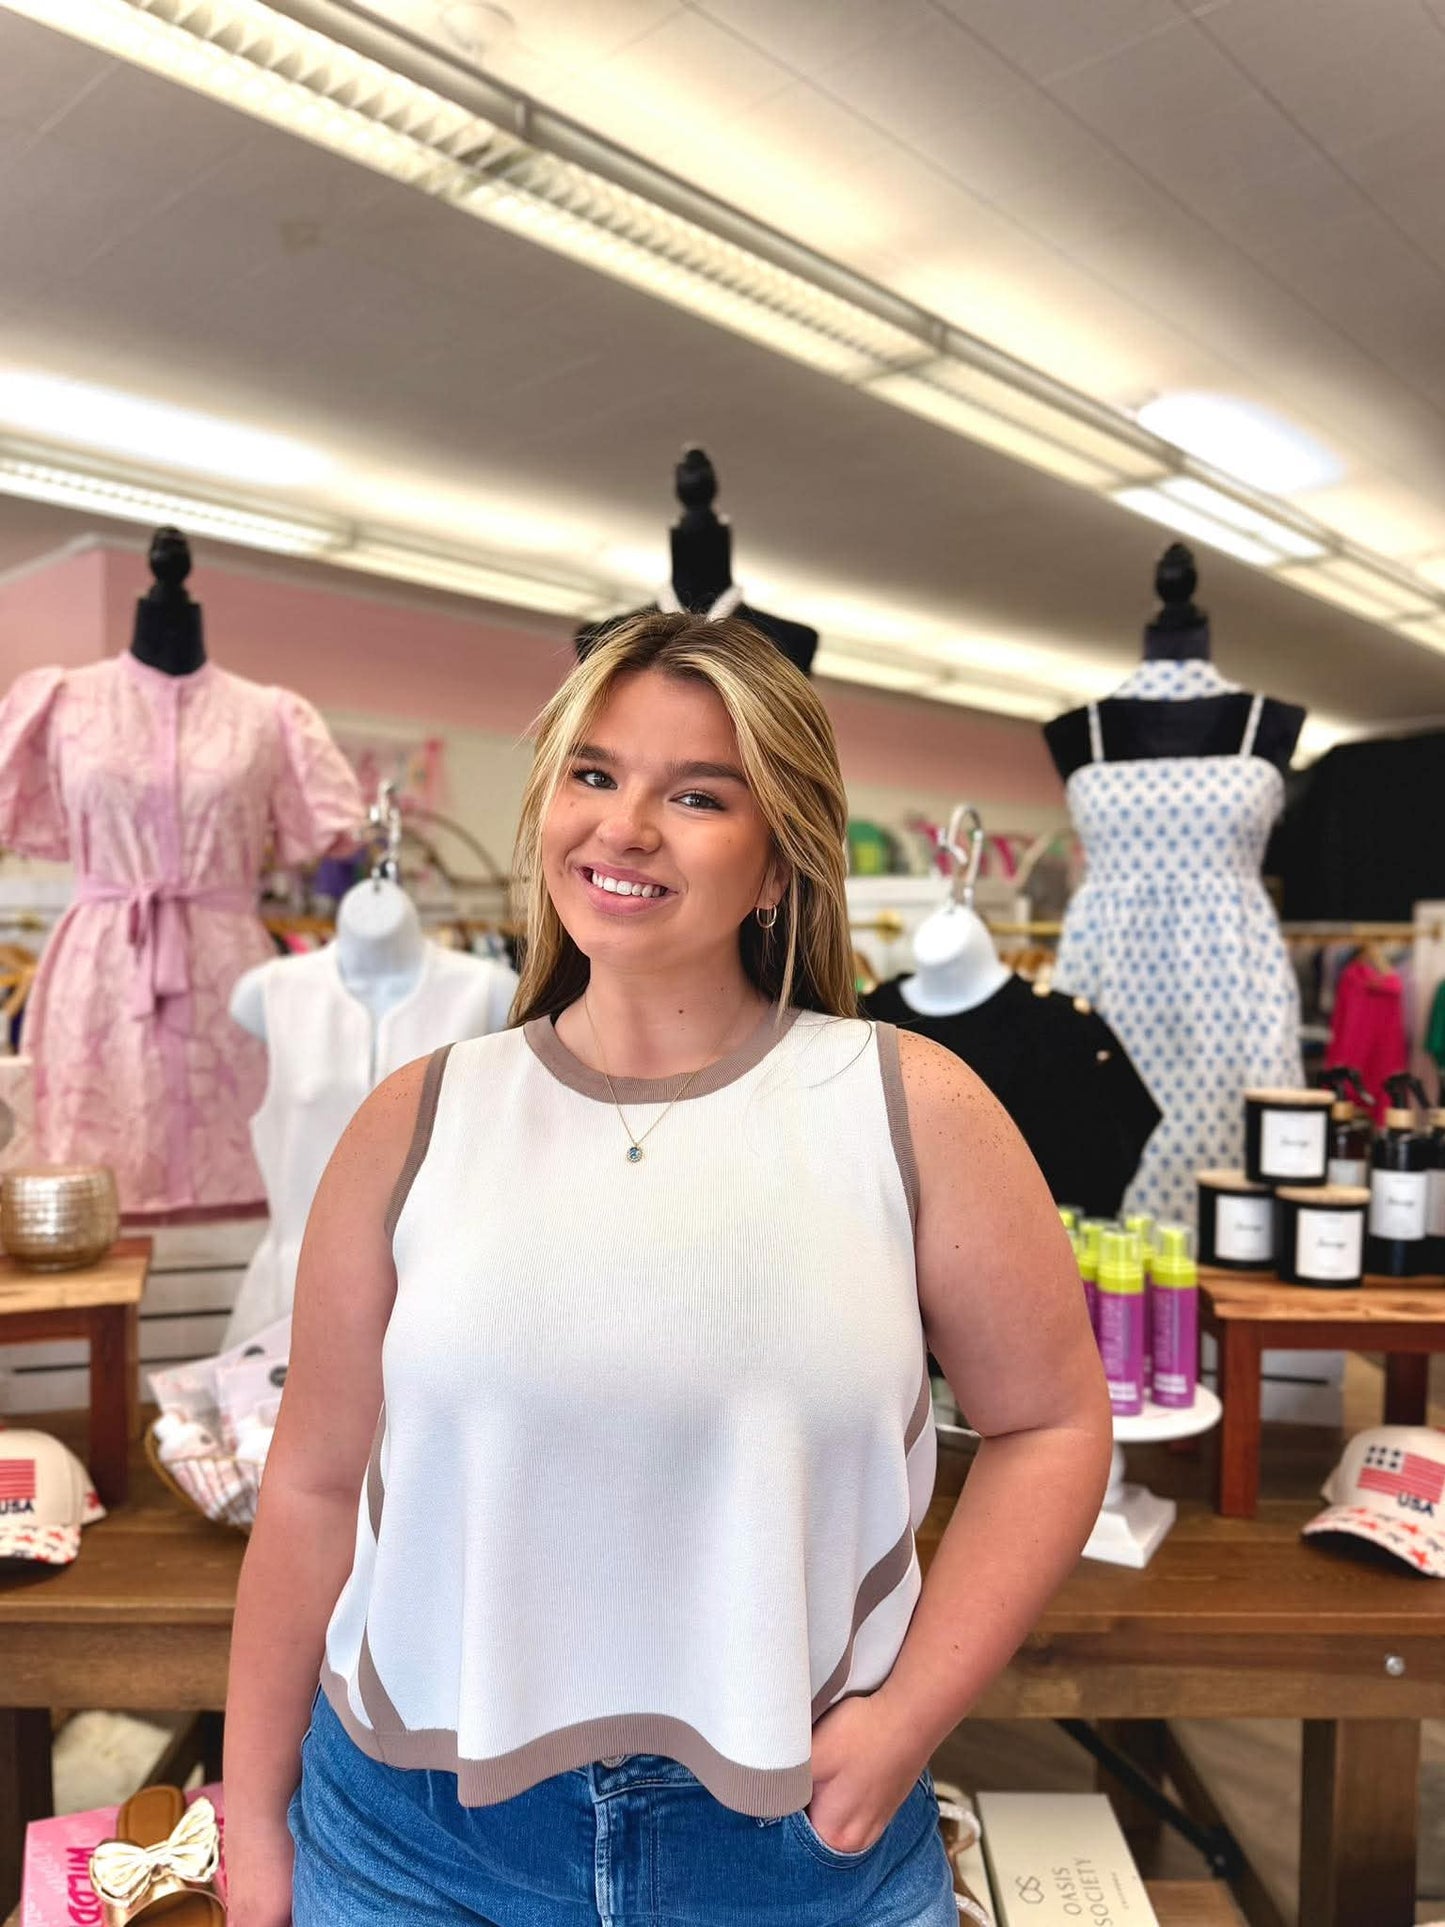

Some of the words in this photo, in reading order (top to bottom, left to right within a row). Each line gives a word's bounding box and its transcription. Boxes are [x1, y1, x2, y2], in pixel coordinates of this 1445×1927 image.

[1398, 1493, 1434, 1517] USA
[66, 1847, 102, 1927] WILDD
[1052, 1866, 1082, 1916] OASIS
[1074, 1857, 1113, 1927] SOCIETY
